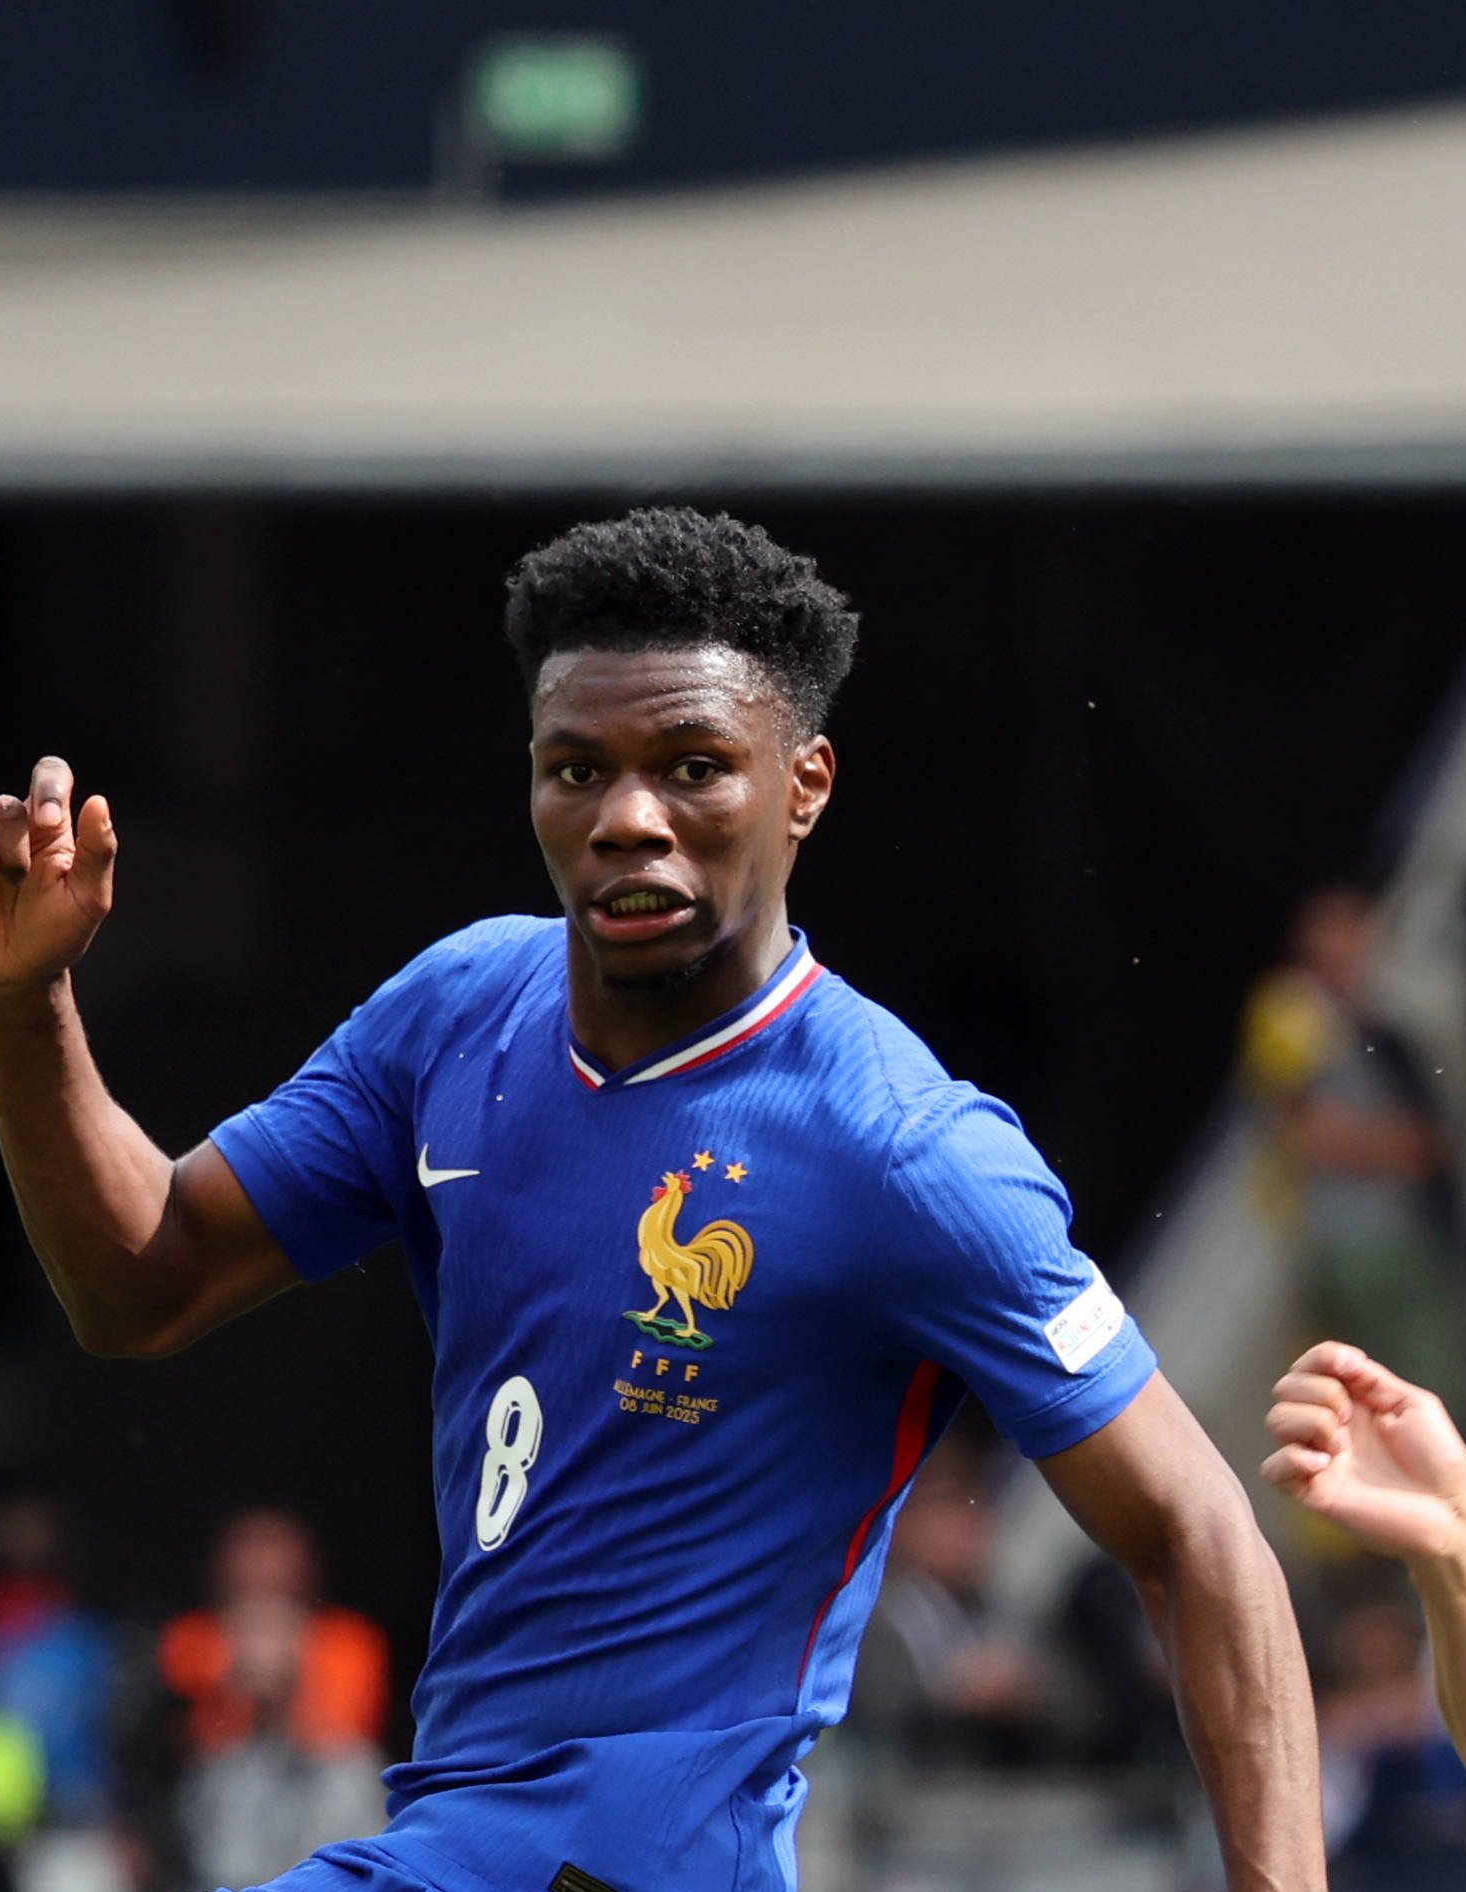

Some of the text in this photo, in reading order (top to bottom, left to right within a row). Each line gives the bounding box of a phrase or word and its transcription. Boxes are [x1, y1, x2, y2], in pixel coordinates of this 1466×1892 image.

[619, 1396, 638, 1413] 08
[665, 1405, 701, 1425] 2025
[676, 1394, 719, 1413] FRANCE
[476, 1375, 543, 1551] 8
